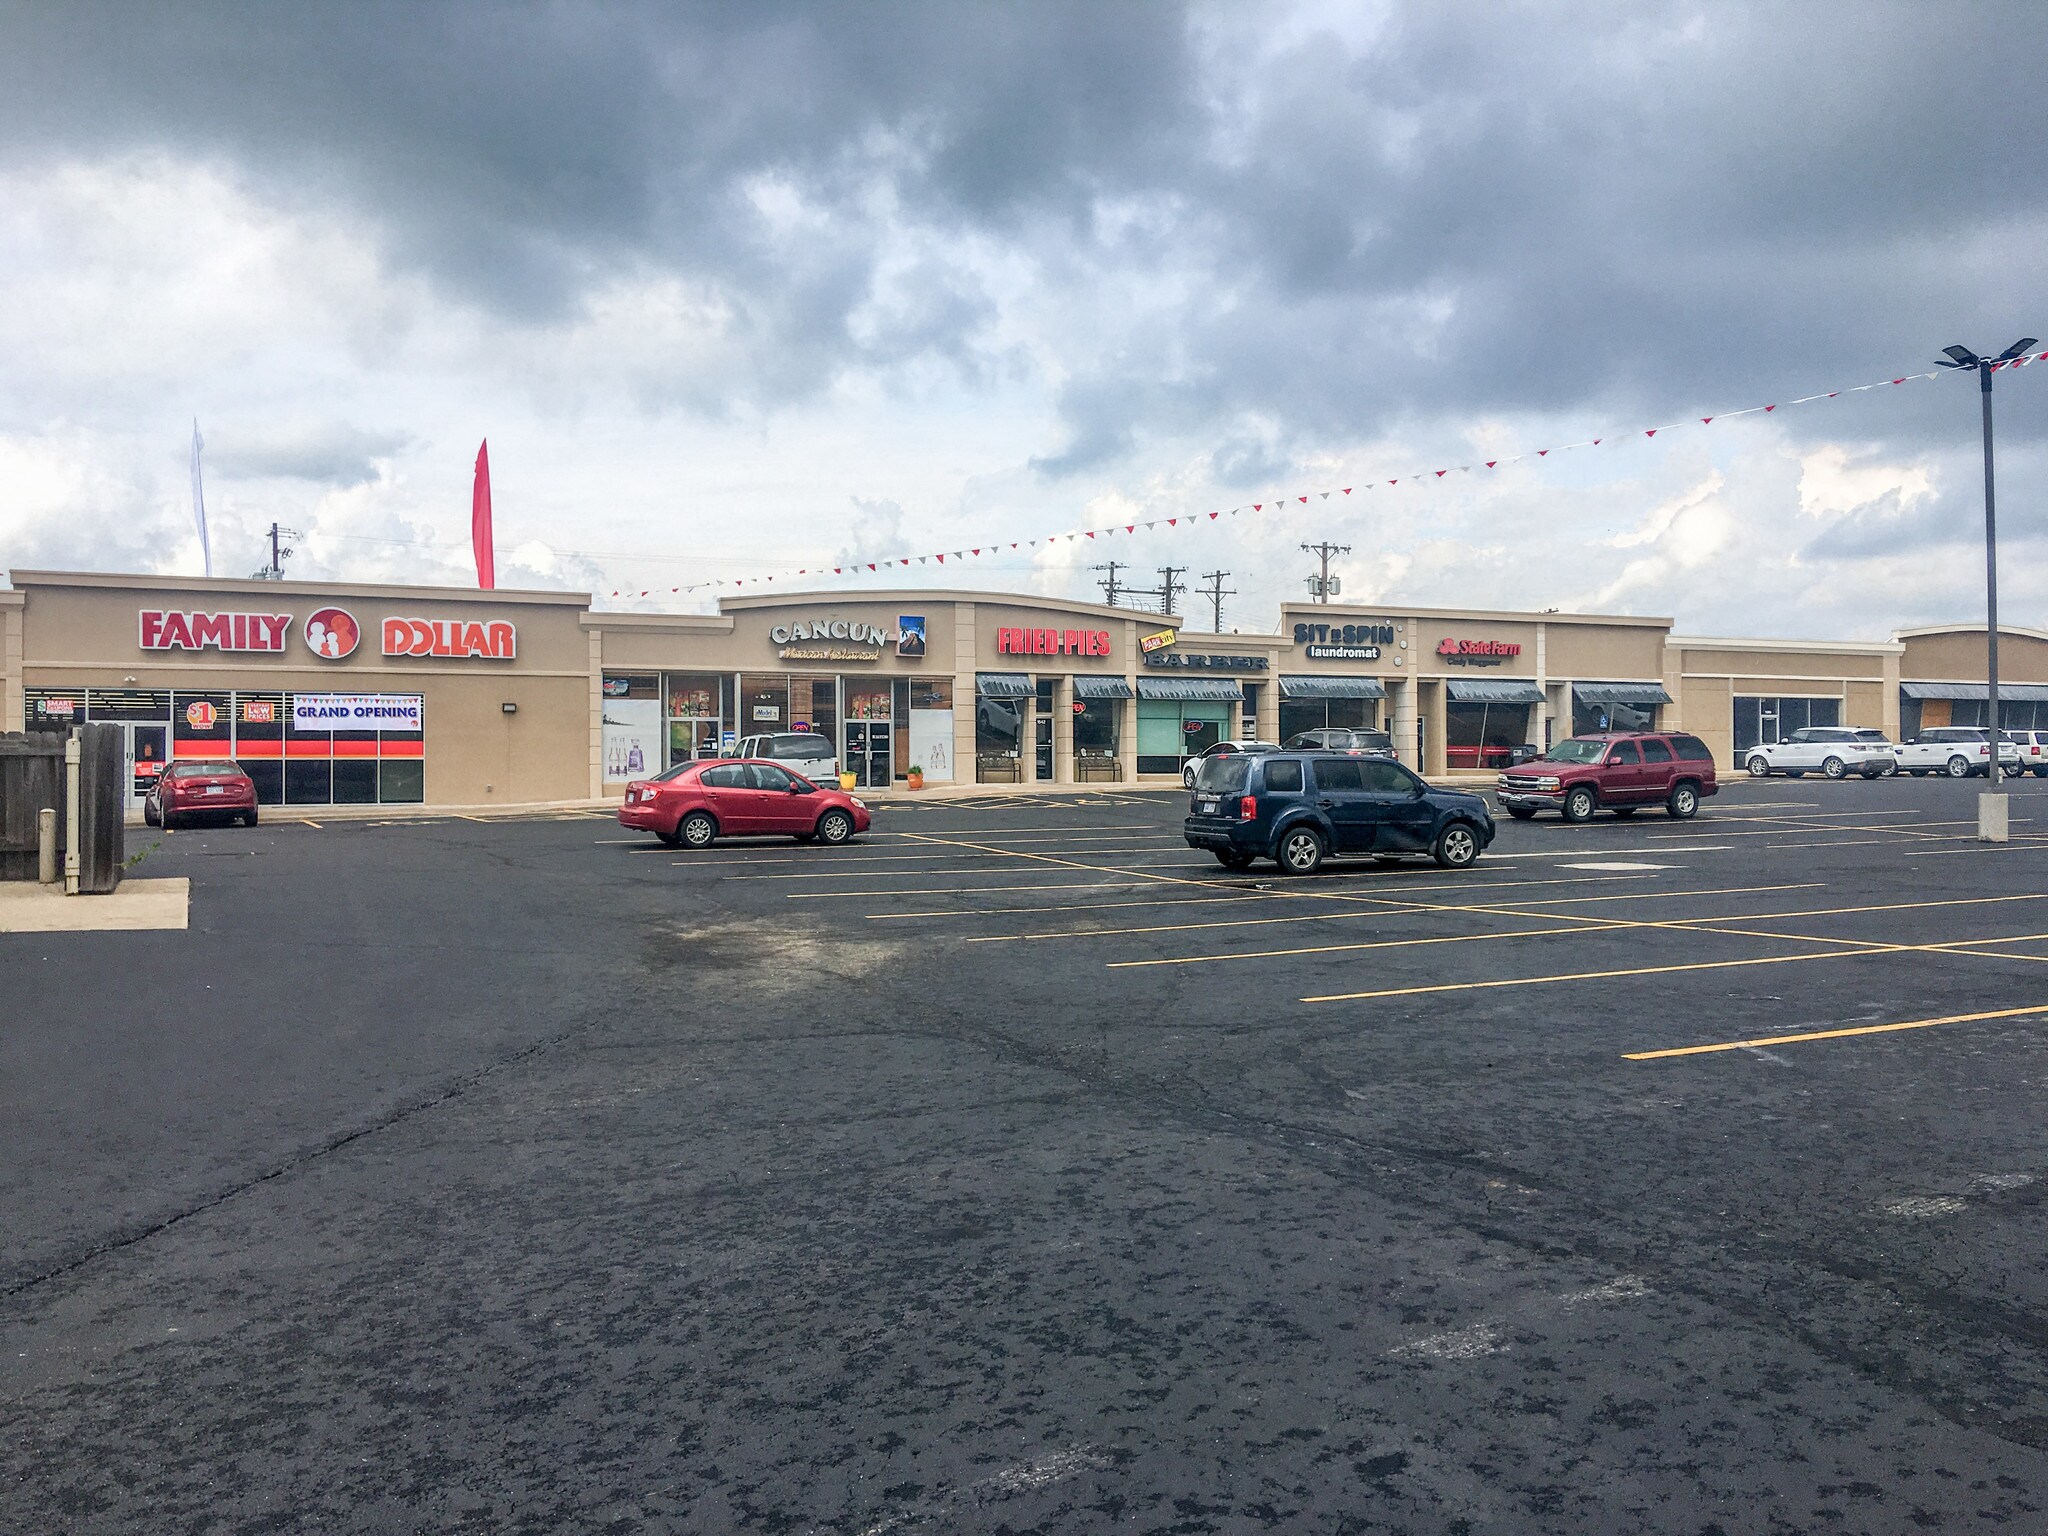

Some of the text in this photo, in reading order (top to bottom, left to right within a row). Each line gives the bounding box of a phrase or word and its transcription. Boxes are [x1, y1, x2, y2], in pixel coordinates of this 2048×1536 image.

[140, 610, 515, 658] FAMILY DOLLAR
[771, 620, 888, 647] CANCUN
[998, 627, 1111, 656] FRIED PIES
[1294, 623, 1330, 643] SIT
[1343, 624, 1394, 645] SPIN
[781, 647, 879, 660] Mexican Restaurant
[1311, 646, 1377, 657] laundromat
[1460, 640, 1521, 656] State Farm
[1143, 653, 1269, 669] BARBER
[297, 706, 417, 718] GRAND OPENING
[792, 724, 809, 732] OPEN
